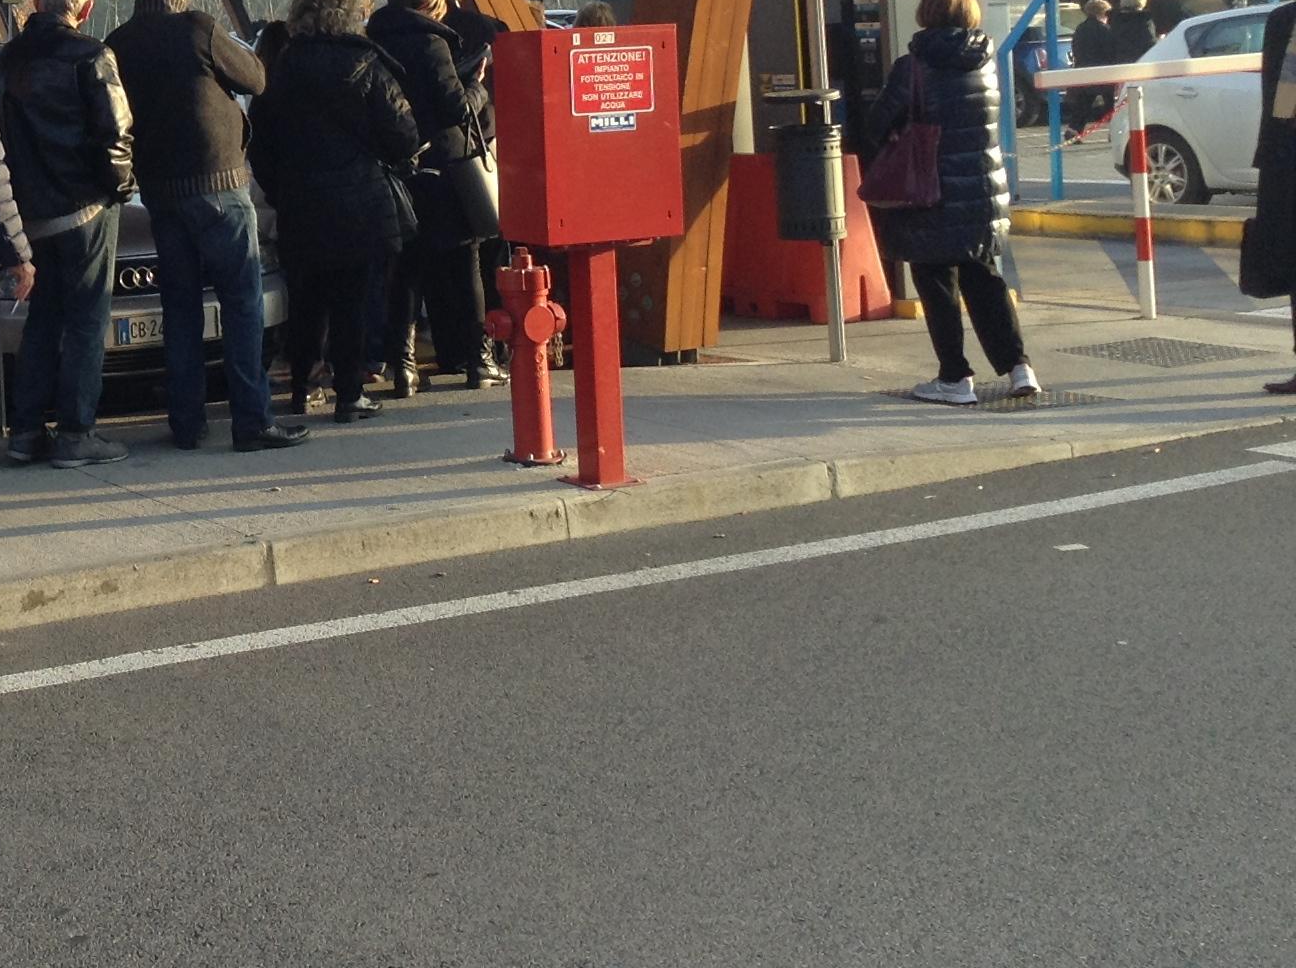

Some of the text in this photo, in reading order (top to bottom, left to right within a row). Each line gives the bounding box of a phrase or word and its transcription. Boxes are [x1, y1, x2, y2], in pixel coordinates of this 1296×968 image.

[578, 51, 646, 64] ATTENZIONE!
[595, 65, 630, 73] IMPIANTO
[580, 73, 634, 83] FOTOVOLTAICO
[594, 83, 631, 91] TENSIONE
[600, 91, 643, 100] UTILIZZARE
[600, 101, 626, 110] ACQUA
[131, 321, 147, 339] CB
